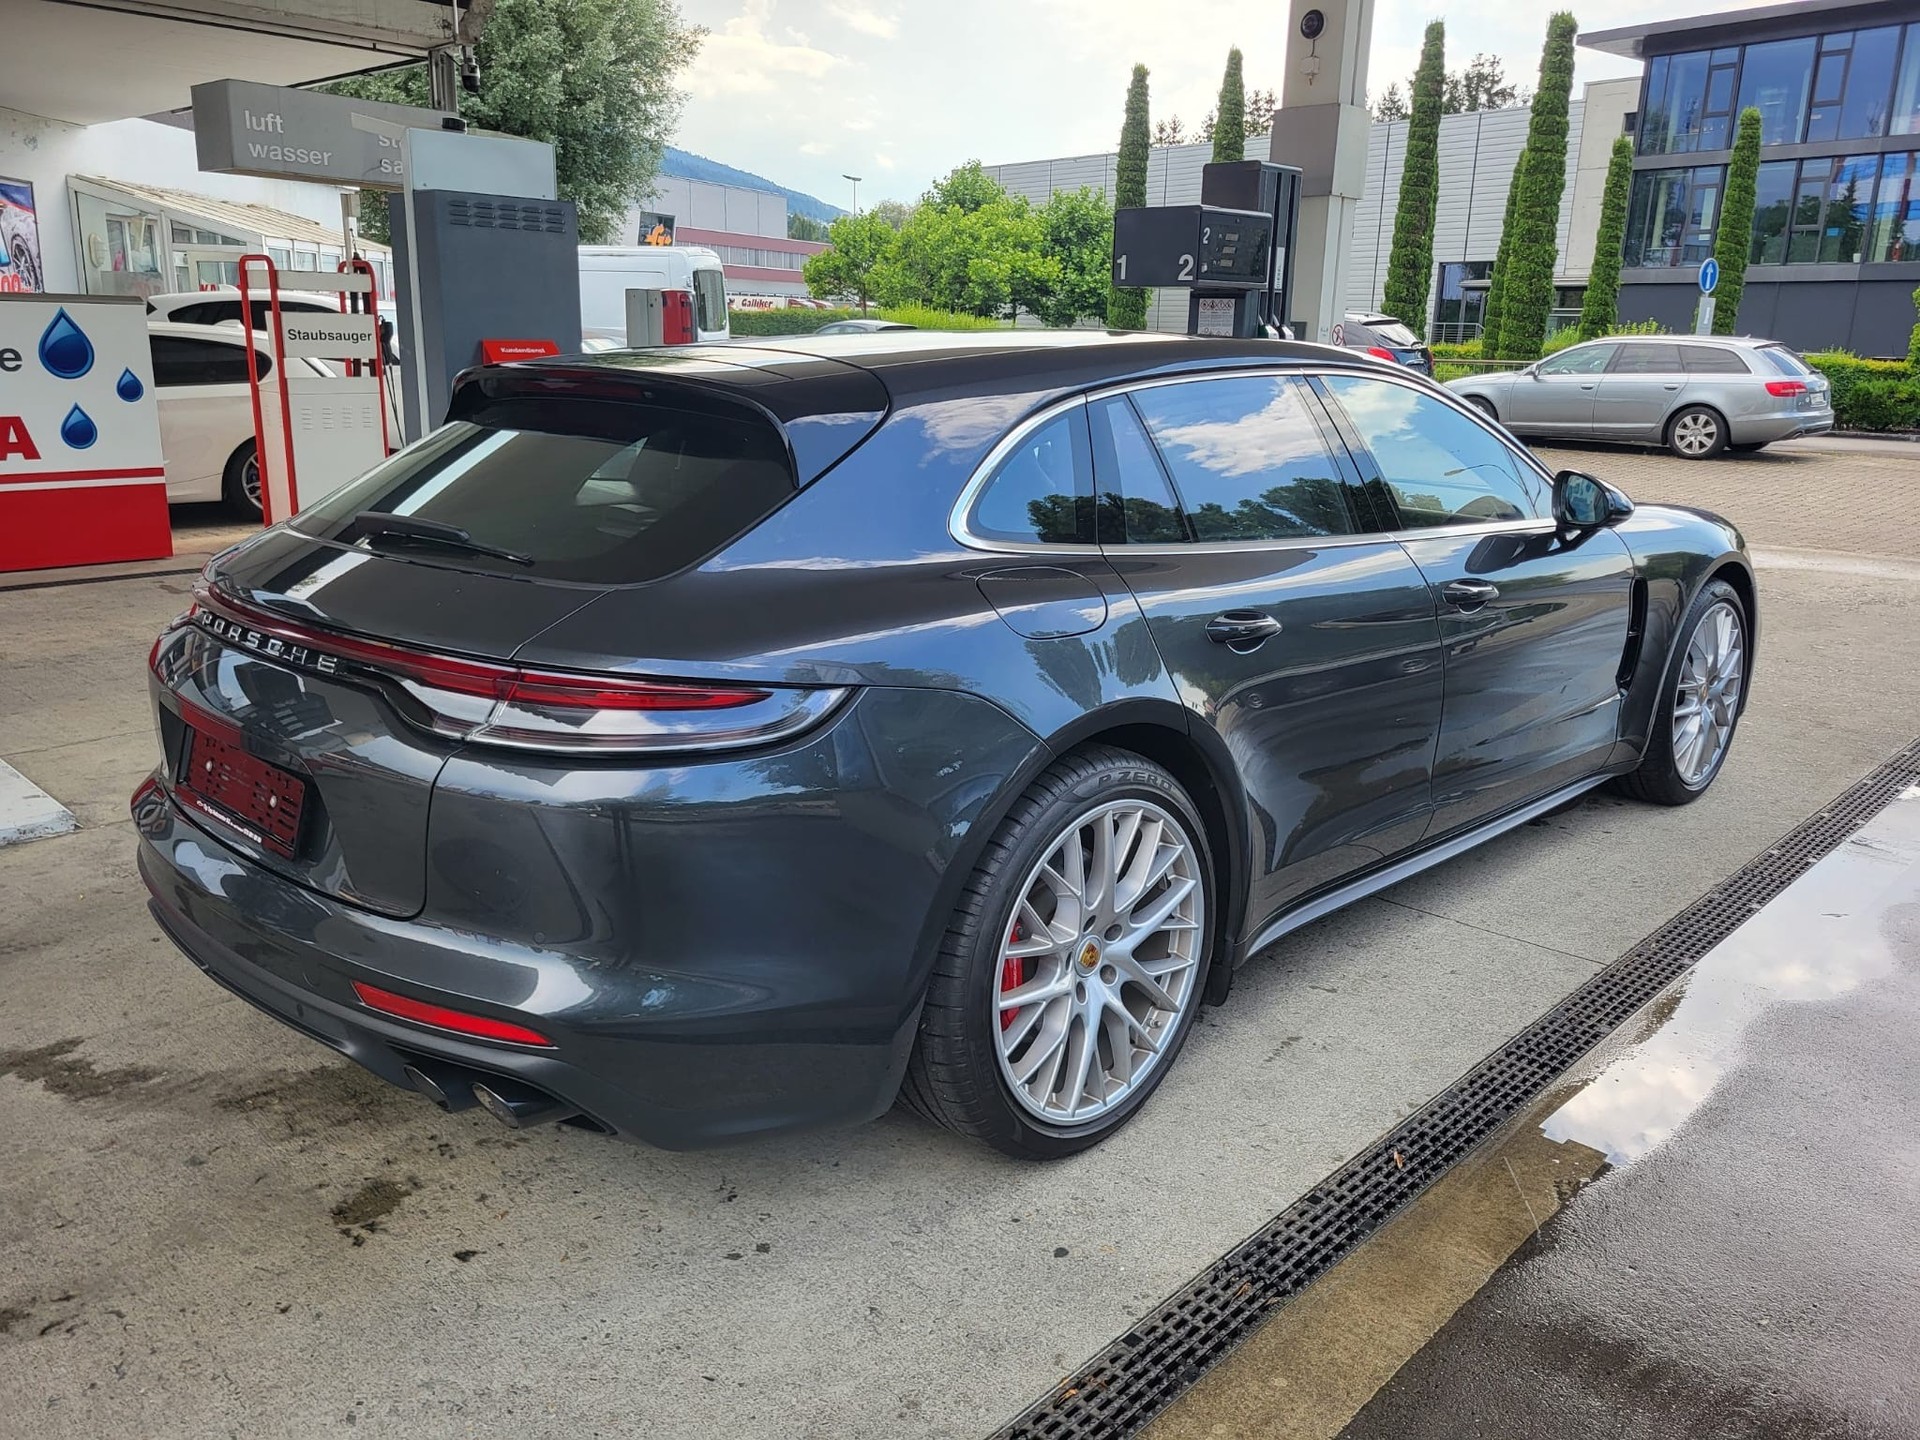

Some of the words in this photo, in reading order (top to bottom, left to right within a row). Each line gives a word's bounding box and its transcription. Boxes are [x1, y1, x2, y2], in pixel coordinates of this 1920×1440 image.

[244, 110, 284, 134] luft
[248, 142, 332, 166] wasser
[1202, 226, 1211, 245] 2
[1116, 254, 1127, 280] 1
[1177, 253, 1194, 281] 2
[741, 298, 774, 310] Galliker
[287, 328, 373, 344] Staubsauger
[0, 347, 23, 372] e
[0, 415, 42, 461] A
[201, 613, 338, 675] PORSCHE
[1098, 773, 1112, 788] P
[1117, 771, 1174, 792] ZERO
